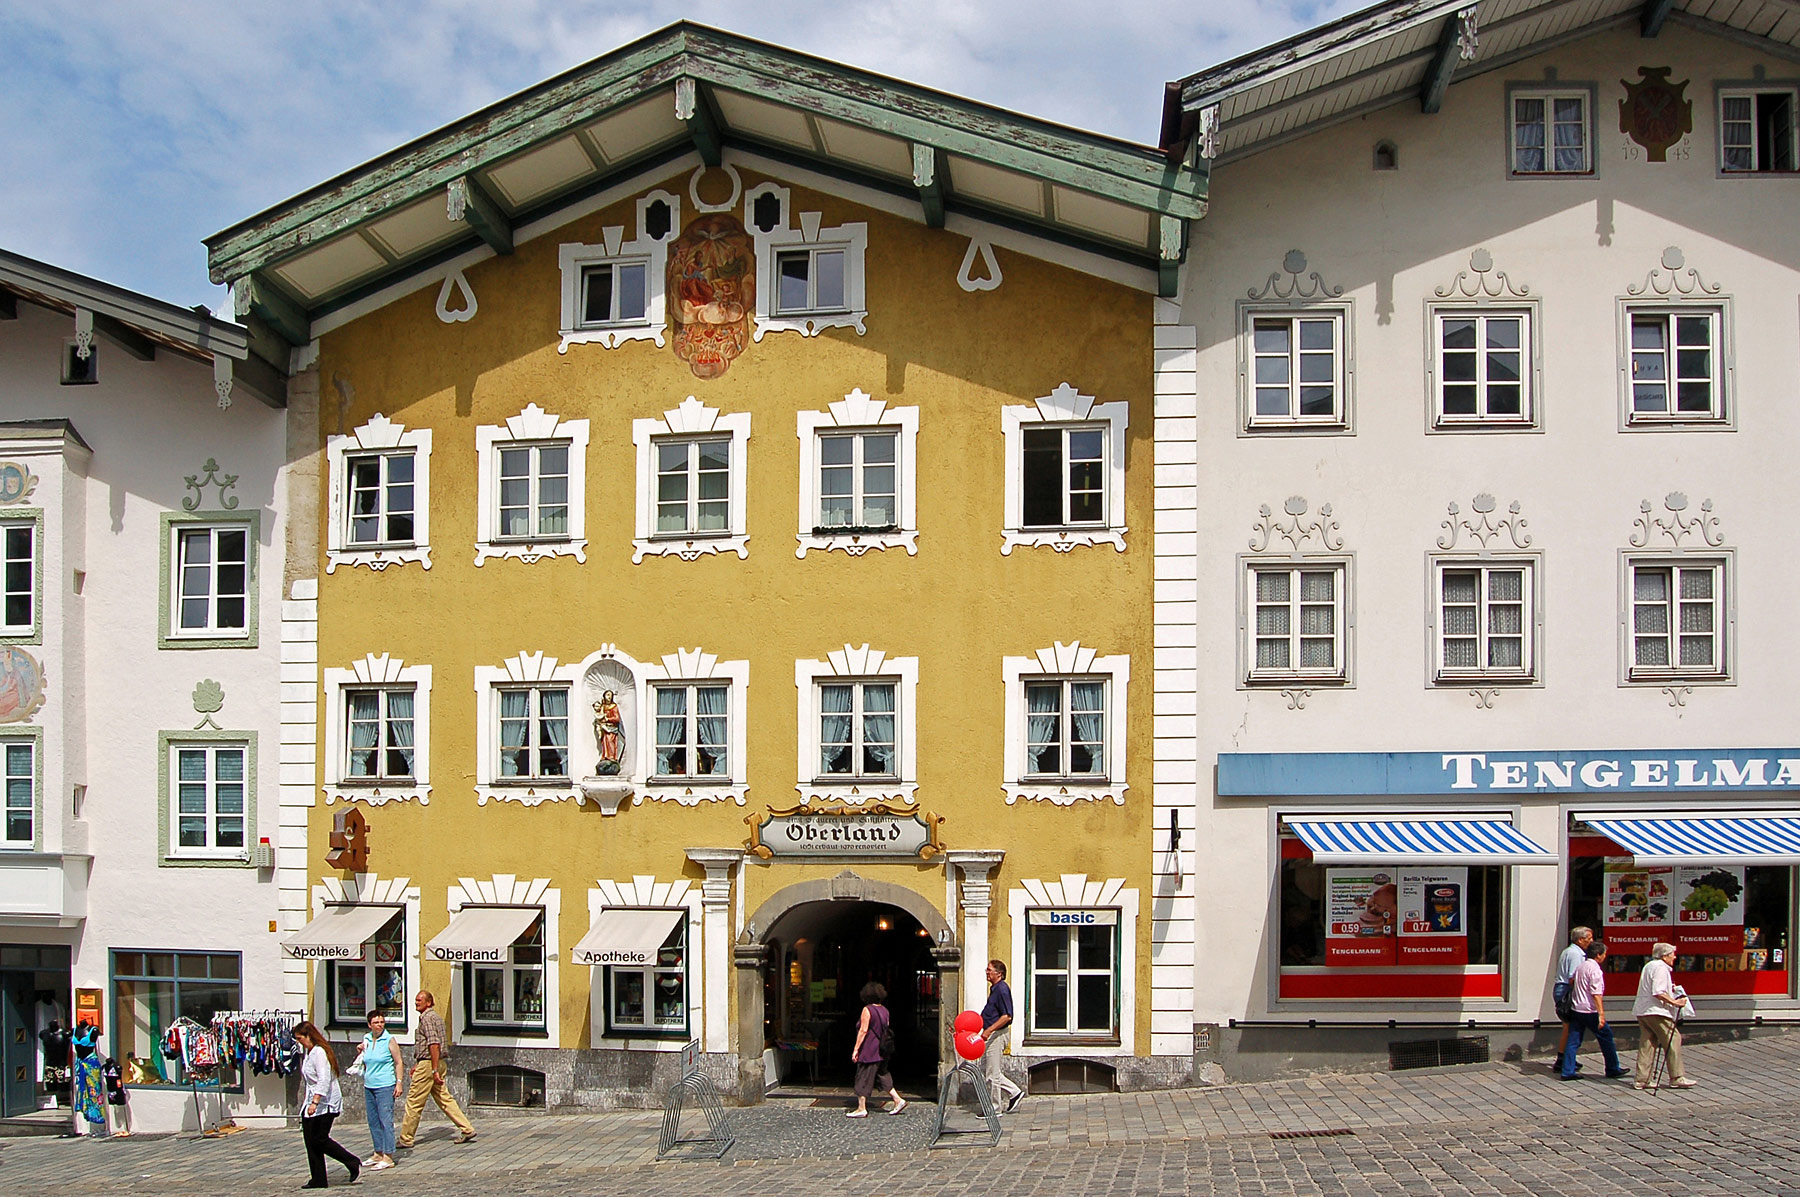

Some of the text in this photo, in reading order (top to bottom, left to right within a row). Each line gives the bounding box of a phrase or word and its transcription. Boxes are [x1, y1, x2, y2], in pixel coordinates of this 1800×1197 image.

[1441, 754, 1800, 789] TENGELMA
[785, 822, 902, 841] Oberland
[1050, 911, 1095, 924] basic
[1688, 910, 1707, 921] 1.99
[1341, 923, 1359, 933] 0.59
[1412, 922, 1430, 932] 0.77
[292, 946, 349, 959] Apotheke
[435, 948, 499, 960] Oberland
[583, 951, 645, 963] Apotheke
